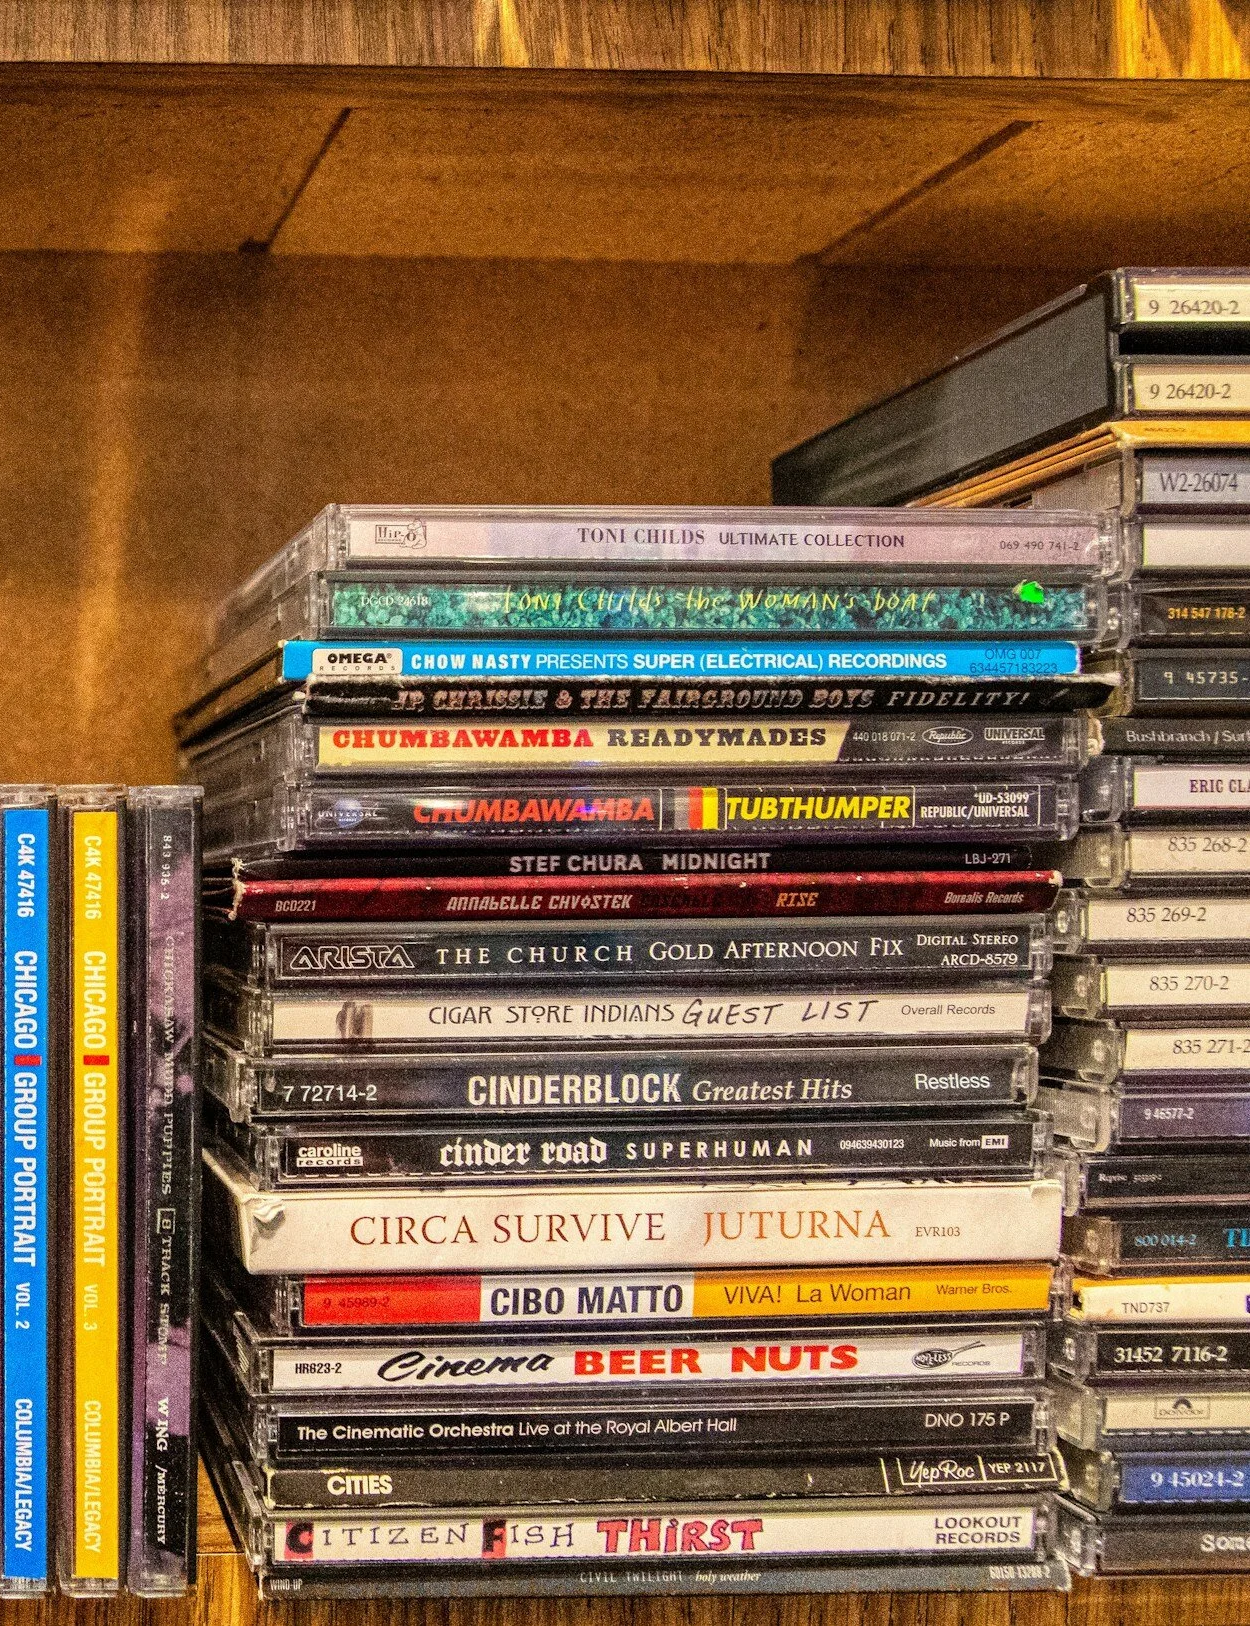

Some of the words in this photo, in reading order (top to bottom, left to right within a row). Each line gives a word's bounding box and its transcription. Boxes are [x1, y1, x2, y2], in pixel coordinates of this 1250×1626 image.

[1172, 301, 1239, 314] 26420-2
[1166, 384, 1231, 399] 26420-2
[1160, 473, 1238, 492] W2-26074
[577, 528, 626, 543] TONI
[635, 529, 705, 544] CHILDS
[719, 532, 798, 545] ULTIMATE
[804, 533, 904, 547] COLLECTION
[1168, 608, 1187, 619] 314
[411, 655, 465, 669] CHOW
[472, 654, 530, 669] NASTY
[536, 654, 628, 669] PRESENTS
[633, 654, 695, 669] SUPER
[700, 652, 823, 670] (ELECTRICAL)
[828, 653, 947, 669] RECORDINGS
[984, 649, 1015, 659] OMG
[970, 663, 1058, 674] 634457183223
[433, 691, 548, 709] CHRISSIE
[333, 729, 593, 748] CHUMBAWAMBA
[608, 729, 826, 747] READYMADES
[1126, 730, 1210, 742] Bushbranch
[1190, 780, 1223, 793] ERIC
[414, 798, 654, 823] CHUMBAWAMBA
[727, 796, 910, 820] TUBTHUMPER
[920, 805, 1029, 820] REPUBLIC/UNIVERSAL
[18, 834, 35, 868] C4K
[1202, 838, 1247, 852] 268-2
[509, 856, 562, 872] STEF
[568, 854, 643, 871] CHURA
[662, 853, 770, 870] MIDNIGHT
[944, 891, 982, 904] Borealis
[985, 891, 1024, 904] Records
[1161, 907, 1206, 922] 269-2
[290, 946, 415, 969] ARISTA
[508, 946, 632, 963] CHURCH
[941, 953, 1018, 967] ARCD-8579
[1185, 976, 1229, 991] 270-2
[14, 950, 37, 1049] CHICAGO
[83, 951, 106, 1049] CHICAGO
[429, 1007, 491, 1024] CIGAR
[584, 1005, 674, 1023] INDIANS
[901, 1005, 943, 1016] Overall
[947, 1004, 995, 1016] Records
[1173, 1040, 1201, 1054] 835
[468, 1073, 681, 1104] CINDERBLOCK
[693, 1081, 795, 1101] Greatest
[802, 1078, 852, 1099] Hits
[915, 1074, 990, 1090] Restless
[14, 1072, 37, 1149] GROUP
[83, 1072, 106, 1150] GROUP
[1153, 1109, 1194, 1119] 46577-2
[162, 1112, 172, 1195] PUPPIES
[299, 1144, 361, 1158] caroline
[626, 1139, 812, 1159] SUPERHUMAN
[298, 1158, 362, 1167] records
[13, 1157, 36, 1266] PORTRAIT
[83, 1157, 106, 1266] PORTRAIT
[350, 1215, 478, 1245] CIRCA
[493, 1213, 665, 1243] SURVIVE
[704, 1210, 890, 1246] JUTURNA
[1134, 1235, 1157, 1245] 800
[491, 1288, 564, 1315] CIBO
[577, 1285, 683, 1315] MATTO
[831, 1284, 911, 1302] Woman
[1122, 1302, 1170, 1313] TND737
[377, 1351, 555, 1382] Cinema
[574, 1349, 702, 1375] BEER
[731, 1345, 858, 1372] NUTS
[1114, 1348, 1162, 1363] 31452
[297, 1426, 328, 1440] The
[332, 1424, 424, 1439] Cinematic
[430, 1423, 514, 1438] Orchestra
[518, 1422, 549, 1436] Live
[575, 1421, 602, 1435] the
[606, 1420, 650, 1436] Royal
[656, 1418, 703, 1433] Albert
[707, 1418, 737, 1432] Hall
[15, 1399, 32, 1552] COLUMBIA/LEGACY
[84, 1400, 101, 1552] COLUMBIA/LEGACY
[988, 1462, 1012, 1475] YEP
[326, 1475, 392, 1496] CITIES
[1168, 1473, 1244, 1486] 45024-2
[935, 1516, 1022, 1530] LOOKOUT
[936, 1531, 1020, 1544] RECORDS
[720, 1571, 761, 1582] weather
